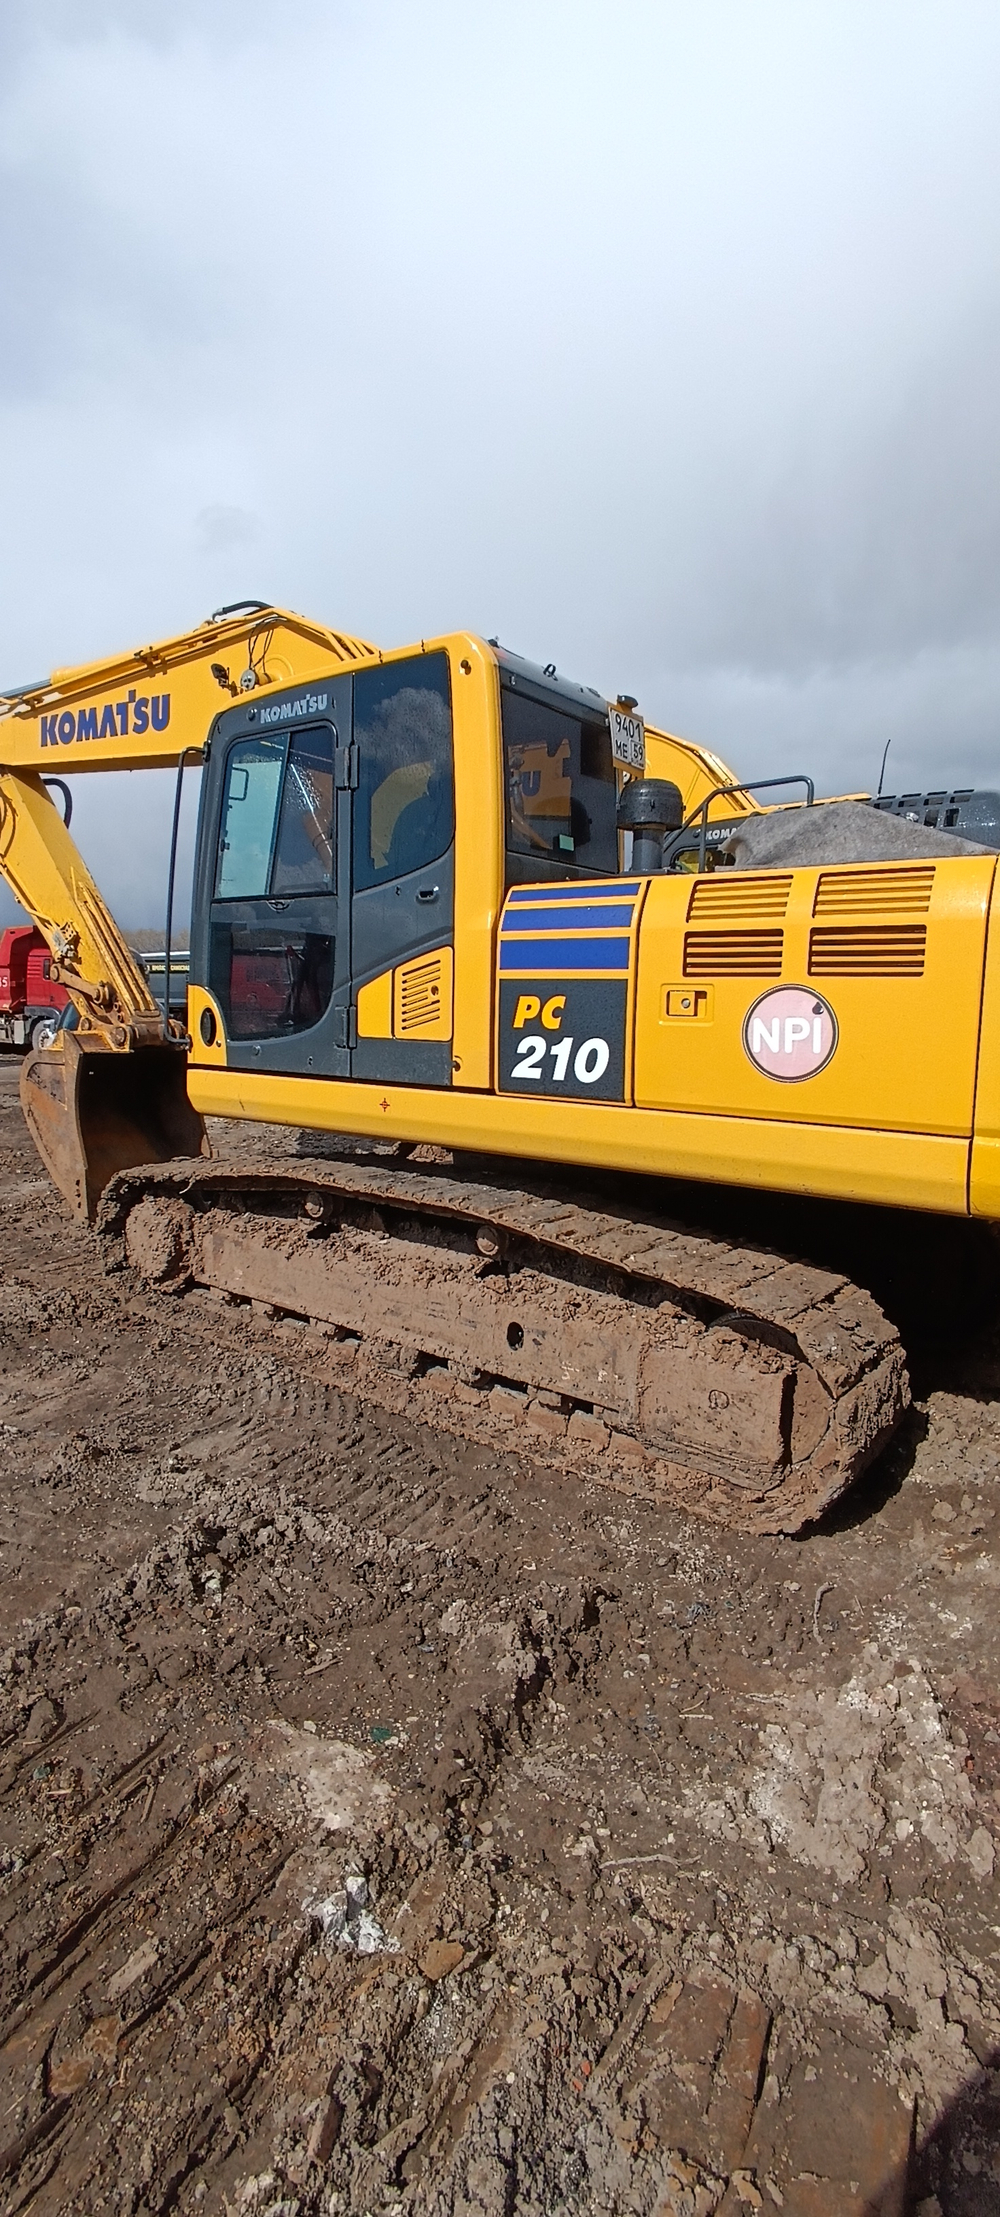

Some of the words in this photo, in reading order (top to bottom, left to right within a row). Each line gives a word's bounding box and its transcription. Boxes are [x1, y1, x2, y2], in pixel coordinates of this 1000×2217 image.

[40, 689, 171, 747] KOMATSU
[260, 693, 328, 724] KOMATSU
[615, 713, 641, 742] 9401
[633, 743, 644, 761] 59
[512, 995, 567, 1030] PC
[510, 1035, 610, 1084] 210
